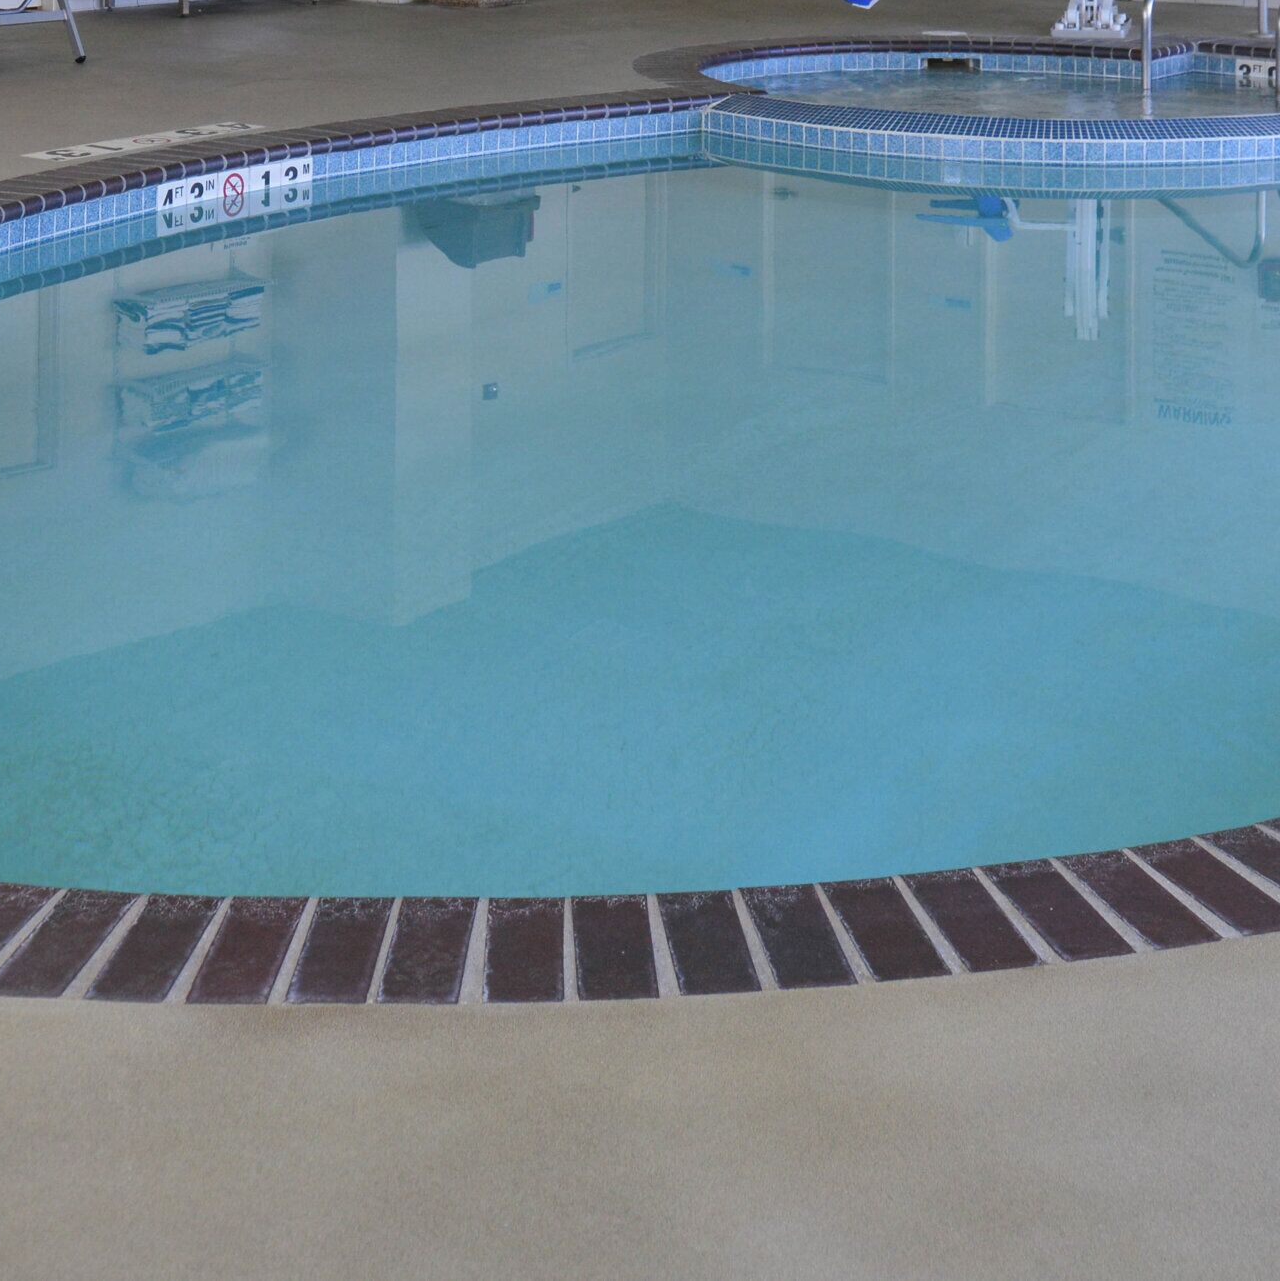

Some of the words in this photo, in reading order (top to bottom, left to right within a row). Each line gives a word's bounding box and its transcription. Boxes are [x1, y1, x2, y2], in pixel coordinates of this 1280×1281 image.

[1252, 64, 1262, 73] FT
[174, 185, 184, 199] FT
[205, 179, 215, 191] IN
[302, 163, 310, 175] M
